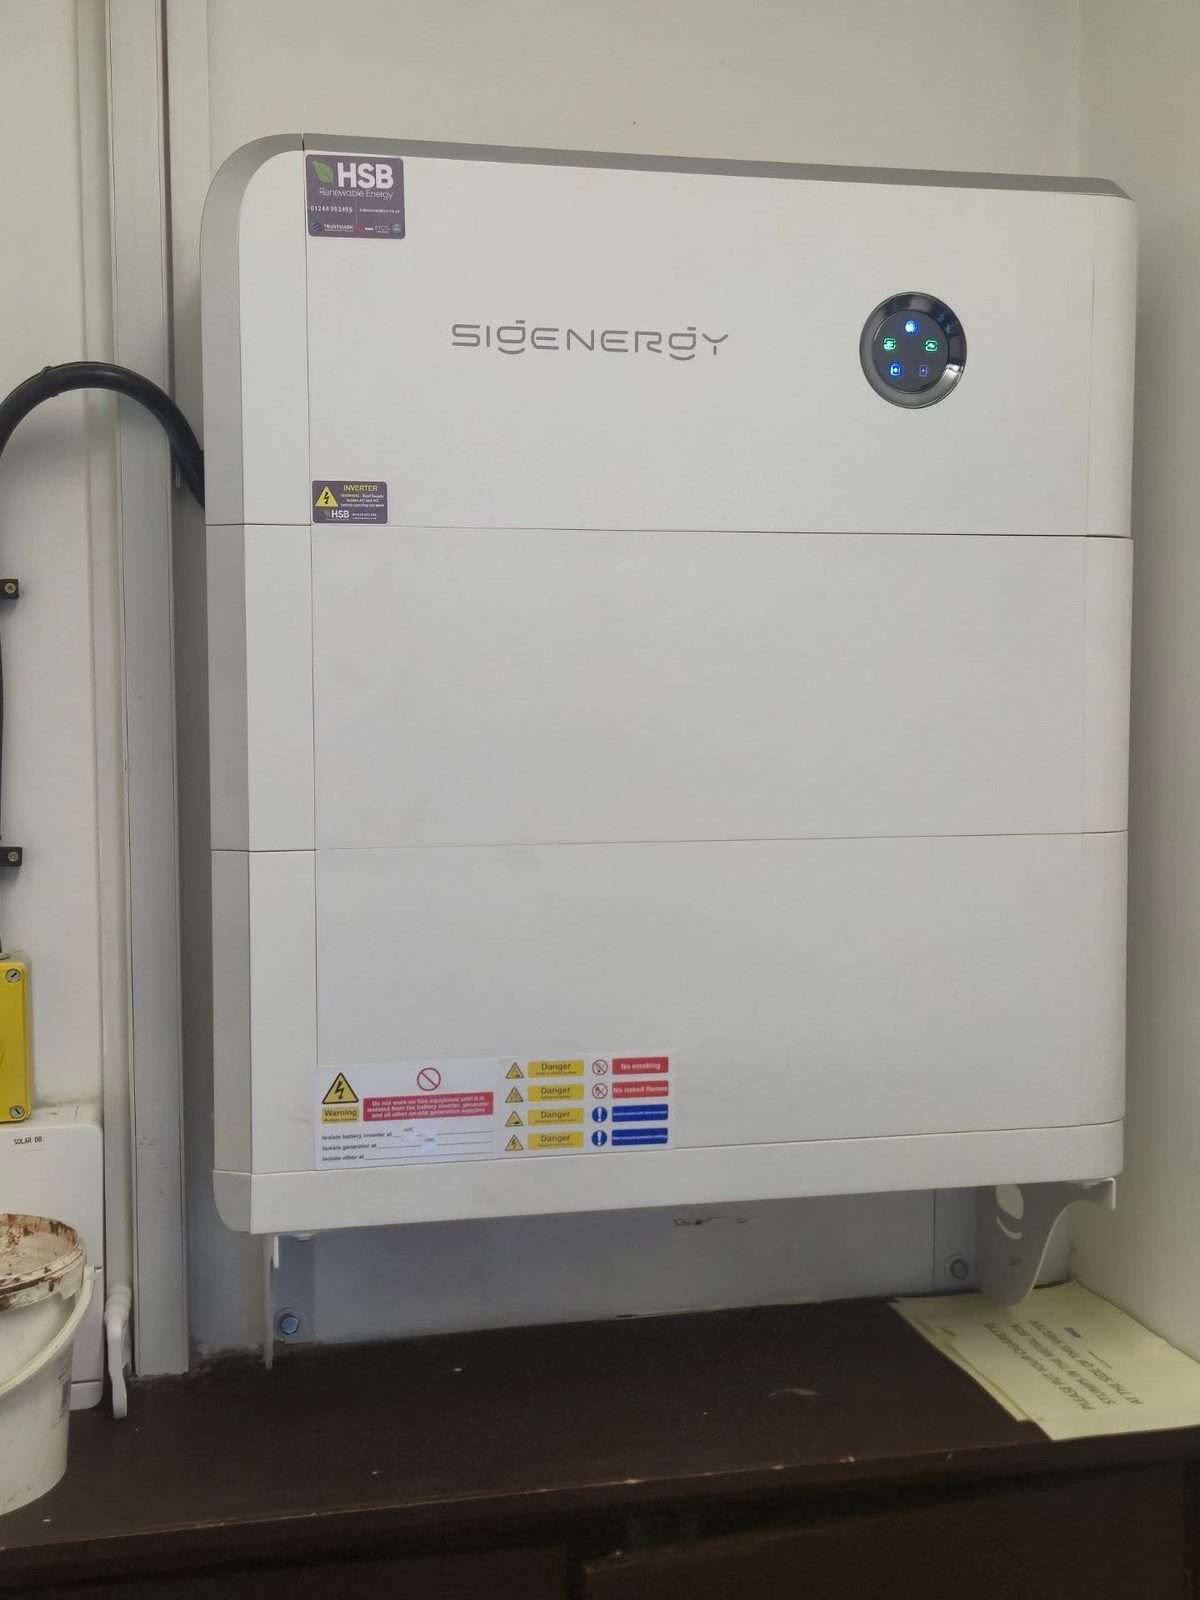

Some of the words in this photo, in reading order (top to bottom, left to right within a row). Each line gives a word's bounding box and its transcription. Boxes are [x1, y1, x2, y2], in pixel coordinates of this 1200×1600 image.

[337, 162, 394, 189] HSB
[320, 187, 364, 198] Renewable
[366, 190, 394, 200] Energy
[343, 484, 378, 492] INVERTER
[331, 509, 350, 519] HSB
[541, 1062, 572, 1072] Danger
[620, 1062, 631, 1070] No
[632, 1061, 661, 1071] smoking
[541, 1086, 571, 1095] Danger
[613, 1086, 623, 1094] No
[324, 1108, 357, 1117] Warning
[540, 1110, 570, 1119] Danger
[342, 1132, 362, 1140] battery
[540, 1134, 570, 1143] Danger
[13, 1137, 31, 1145] SOLAR
[342, 1143, 370, 1151] generator
[1087, 1366, 1113, 1383] SIDE
[1106, 1382, 1131, 1396] THE
[1057, 1385, 1096, 1410] PLEASE
